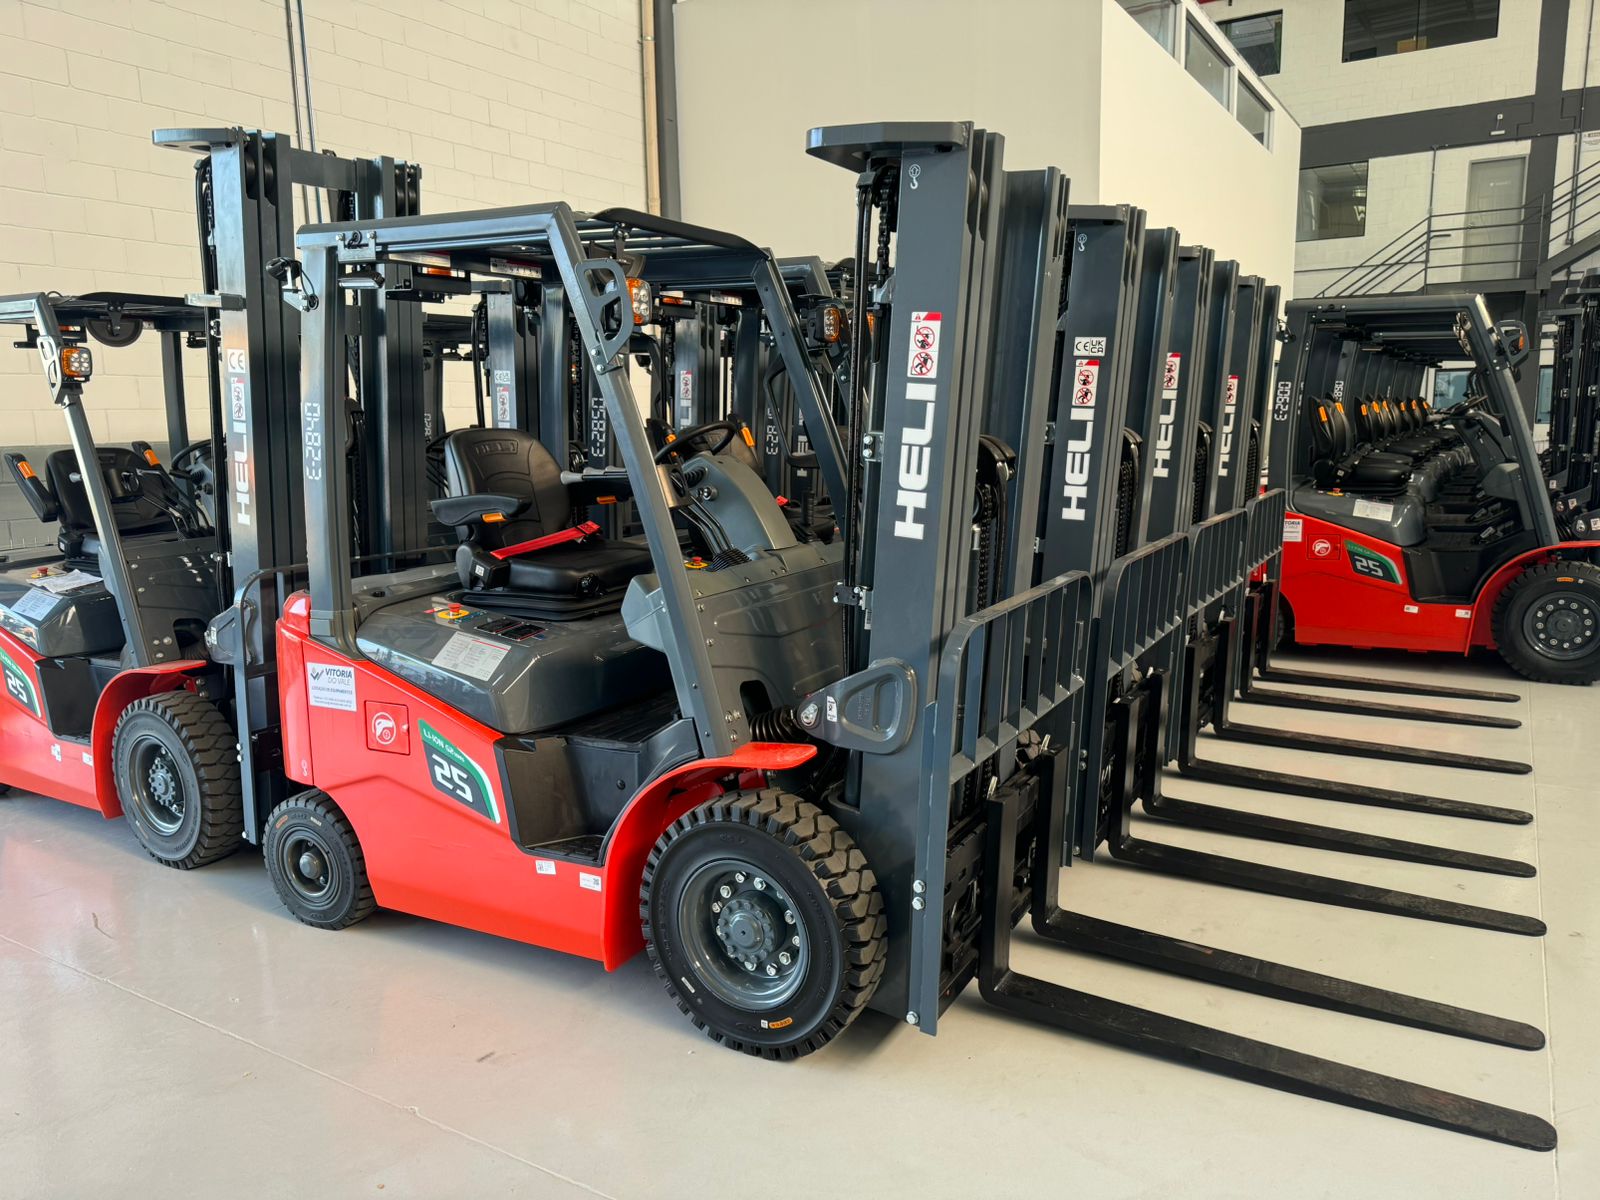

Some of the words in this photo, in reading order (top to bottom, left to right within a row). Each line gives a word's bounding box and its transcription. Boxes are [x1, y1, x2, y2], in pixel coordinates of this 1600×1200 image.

[591, 397, 606, 457] E-2850
[1153, 389, 1178, 478] HELI
[1274, 381, 1291, 421] E-2900
[233, 421, 251, 526] HELI
[304, 402, 322, 480] E-2840
[894, 382, 937, 541] HELI
[1061, 408, 1095, 521] HELI
[1218, 405, 1236, 477] HELI
[1354, 555, 1384, 577] 25
[5, 669, 28, 704] 25
[431, 753, 473, 803] 25
